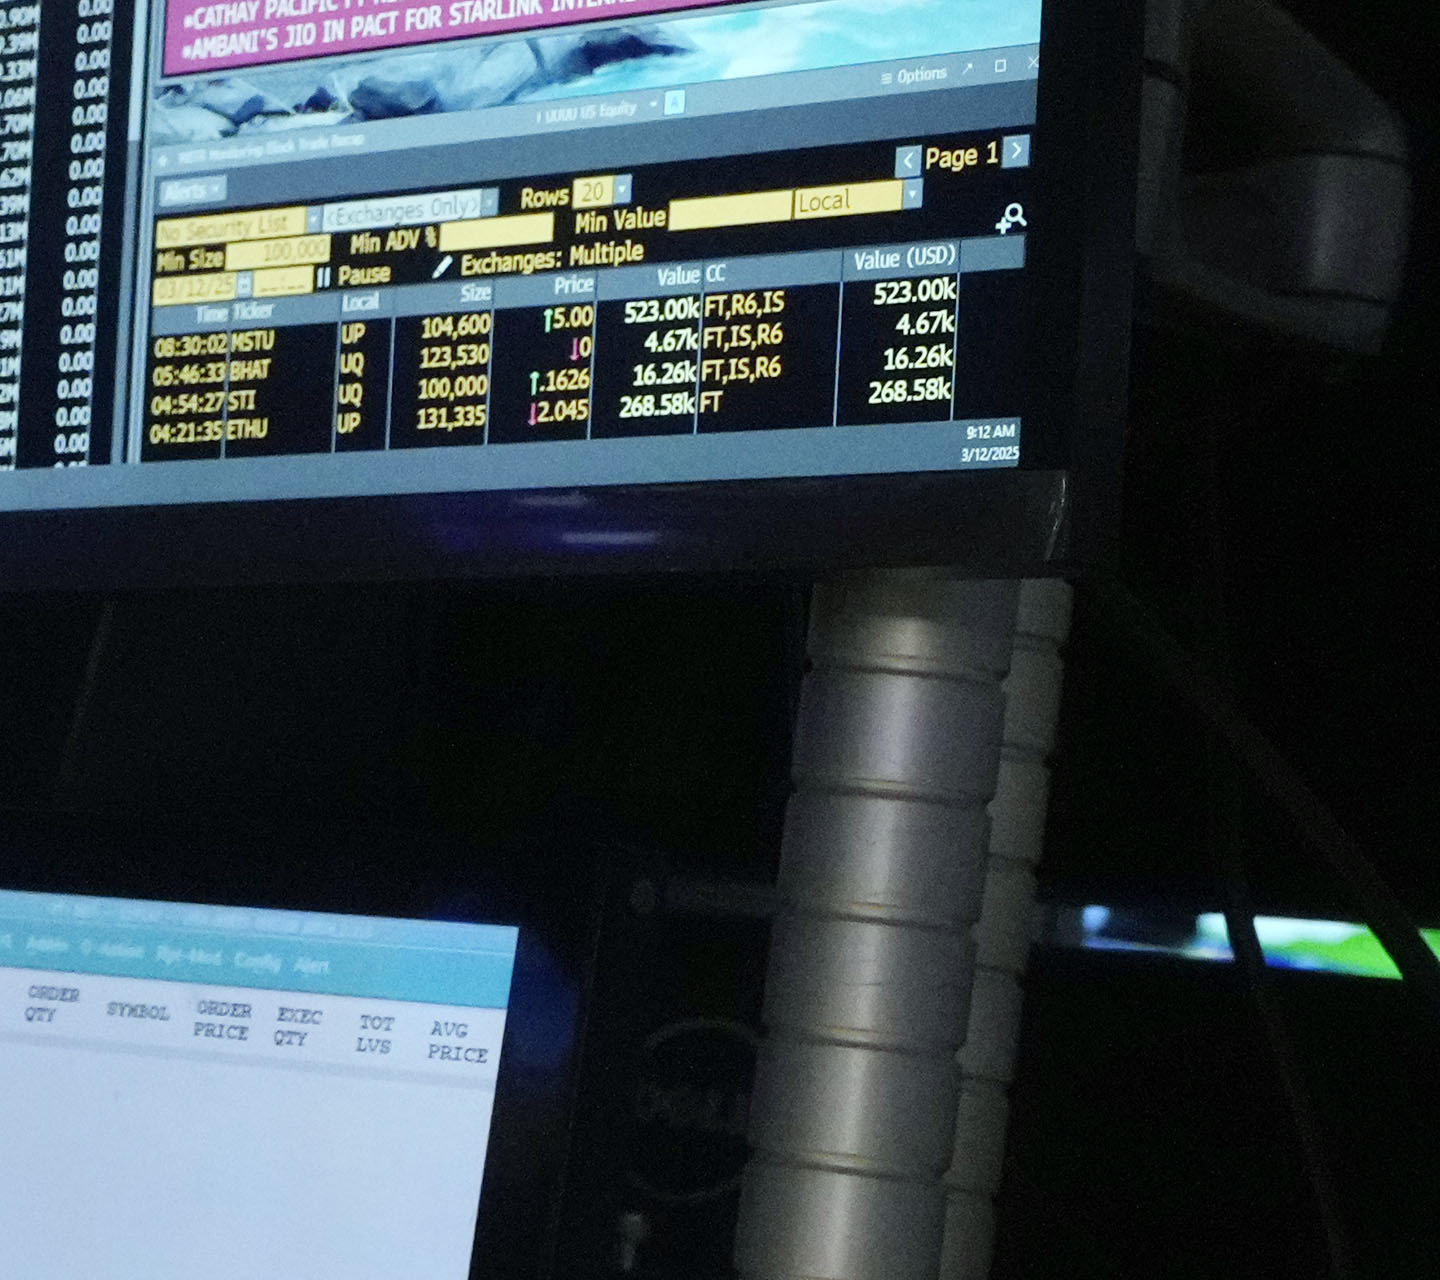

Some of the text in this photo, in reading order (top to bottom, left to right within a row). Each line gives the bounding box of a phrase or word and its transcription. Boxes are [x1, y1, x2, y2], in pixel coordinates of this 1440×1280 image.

[191, 27, 277, 58] AMBANI'S
[284, 22, 316, 47] JIO
[323, 19, 344, 43] IN
[350, 10, 398, 38] PACT
[405, 4, 441, 31] FOR
[897, 65, 948, 85] Options
[925, 141, 999, 172] Page 1
[521, 182, 604, 208] Rows 20
[575, 188, 851, 234] Min Value Local
[350, 226, 439, 255] Min ADV %
[65, 241, 100, 263] 0.00
[190, 247, 224, 269] Size
[461, 240, 644, 277] Exchanges: Multiple
[338, 264, 391, 285] Pause
[342, 290, 379, 312] Local
[460, 283, 491, 303] Size
[554, 276, 594, 297] Price
[658, 267, 700, 286] Value
[706, 264, 725, 282] CC
[855, 250, 900, 271] Value
[906, 246, 956, 268] (USD)
[154, 336, 227, 359] 08:30:02
[342, 323, 366, 345] UP
[421, 313, 491, 340] 104,600
[553, 305, 593, 329] 5.00
[624, 299, 700, 324] 523.00k
[704, 290, 785, 320] FT,R6,IS
[873, 279, 957, 305] 523.00k
[153, 365, 226, 387] 05:46:33
[340, 353, 365, 377] UQ
[419, 344, 489, 369] 123,530
[579, 336, 592, 359] 0
[644, 331, 700, 353] 4.67k
[702, 321, 784, 352] FT,IS,R6
[895, 311, 956, 334] 4.67k
[151, 344, 954, 416] 04:54:27 STI UQ 100,000 .1626 16.26k FT,IS,R6 16.26k
[150, 423, 223, 445] 04:21:35
[336, 411, 361, 435] UP
[415, 404, 486, 428] 131,335
[536, 396, 589, 421] 2.045
[618, 394, 695, 419] 268.58k
[699, 389, 723, 413] FT
[868, 376, 952, 405] 268.58k
[966, 423, 1015, 439] 9:12 AM
[961, 445, 1019, 462] 3/12/2025
[28, 985, 80, 1002] ORDER
[24, 1007, 56, 1022] QTY
[107, 1001, 170, 1021] SYMBOL
[196, 1000, 252, 1018] ORDER
[277, 1007, 323, 1026] EXEC
[193, 1022, 249, 1042] PRICE
[359, 1014, 395, 1032] TOT
[430, 1021, 468, 1038] AVG
[273, 1029, 308, 1047] QTY
[356, 1037, 392, 1054] LVS
[428, 1043, 489, 1064] PRICE
